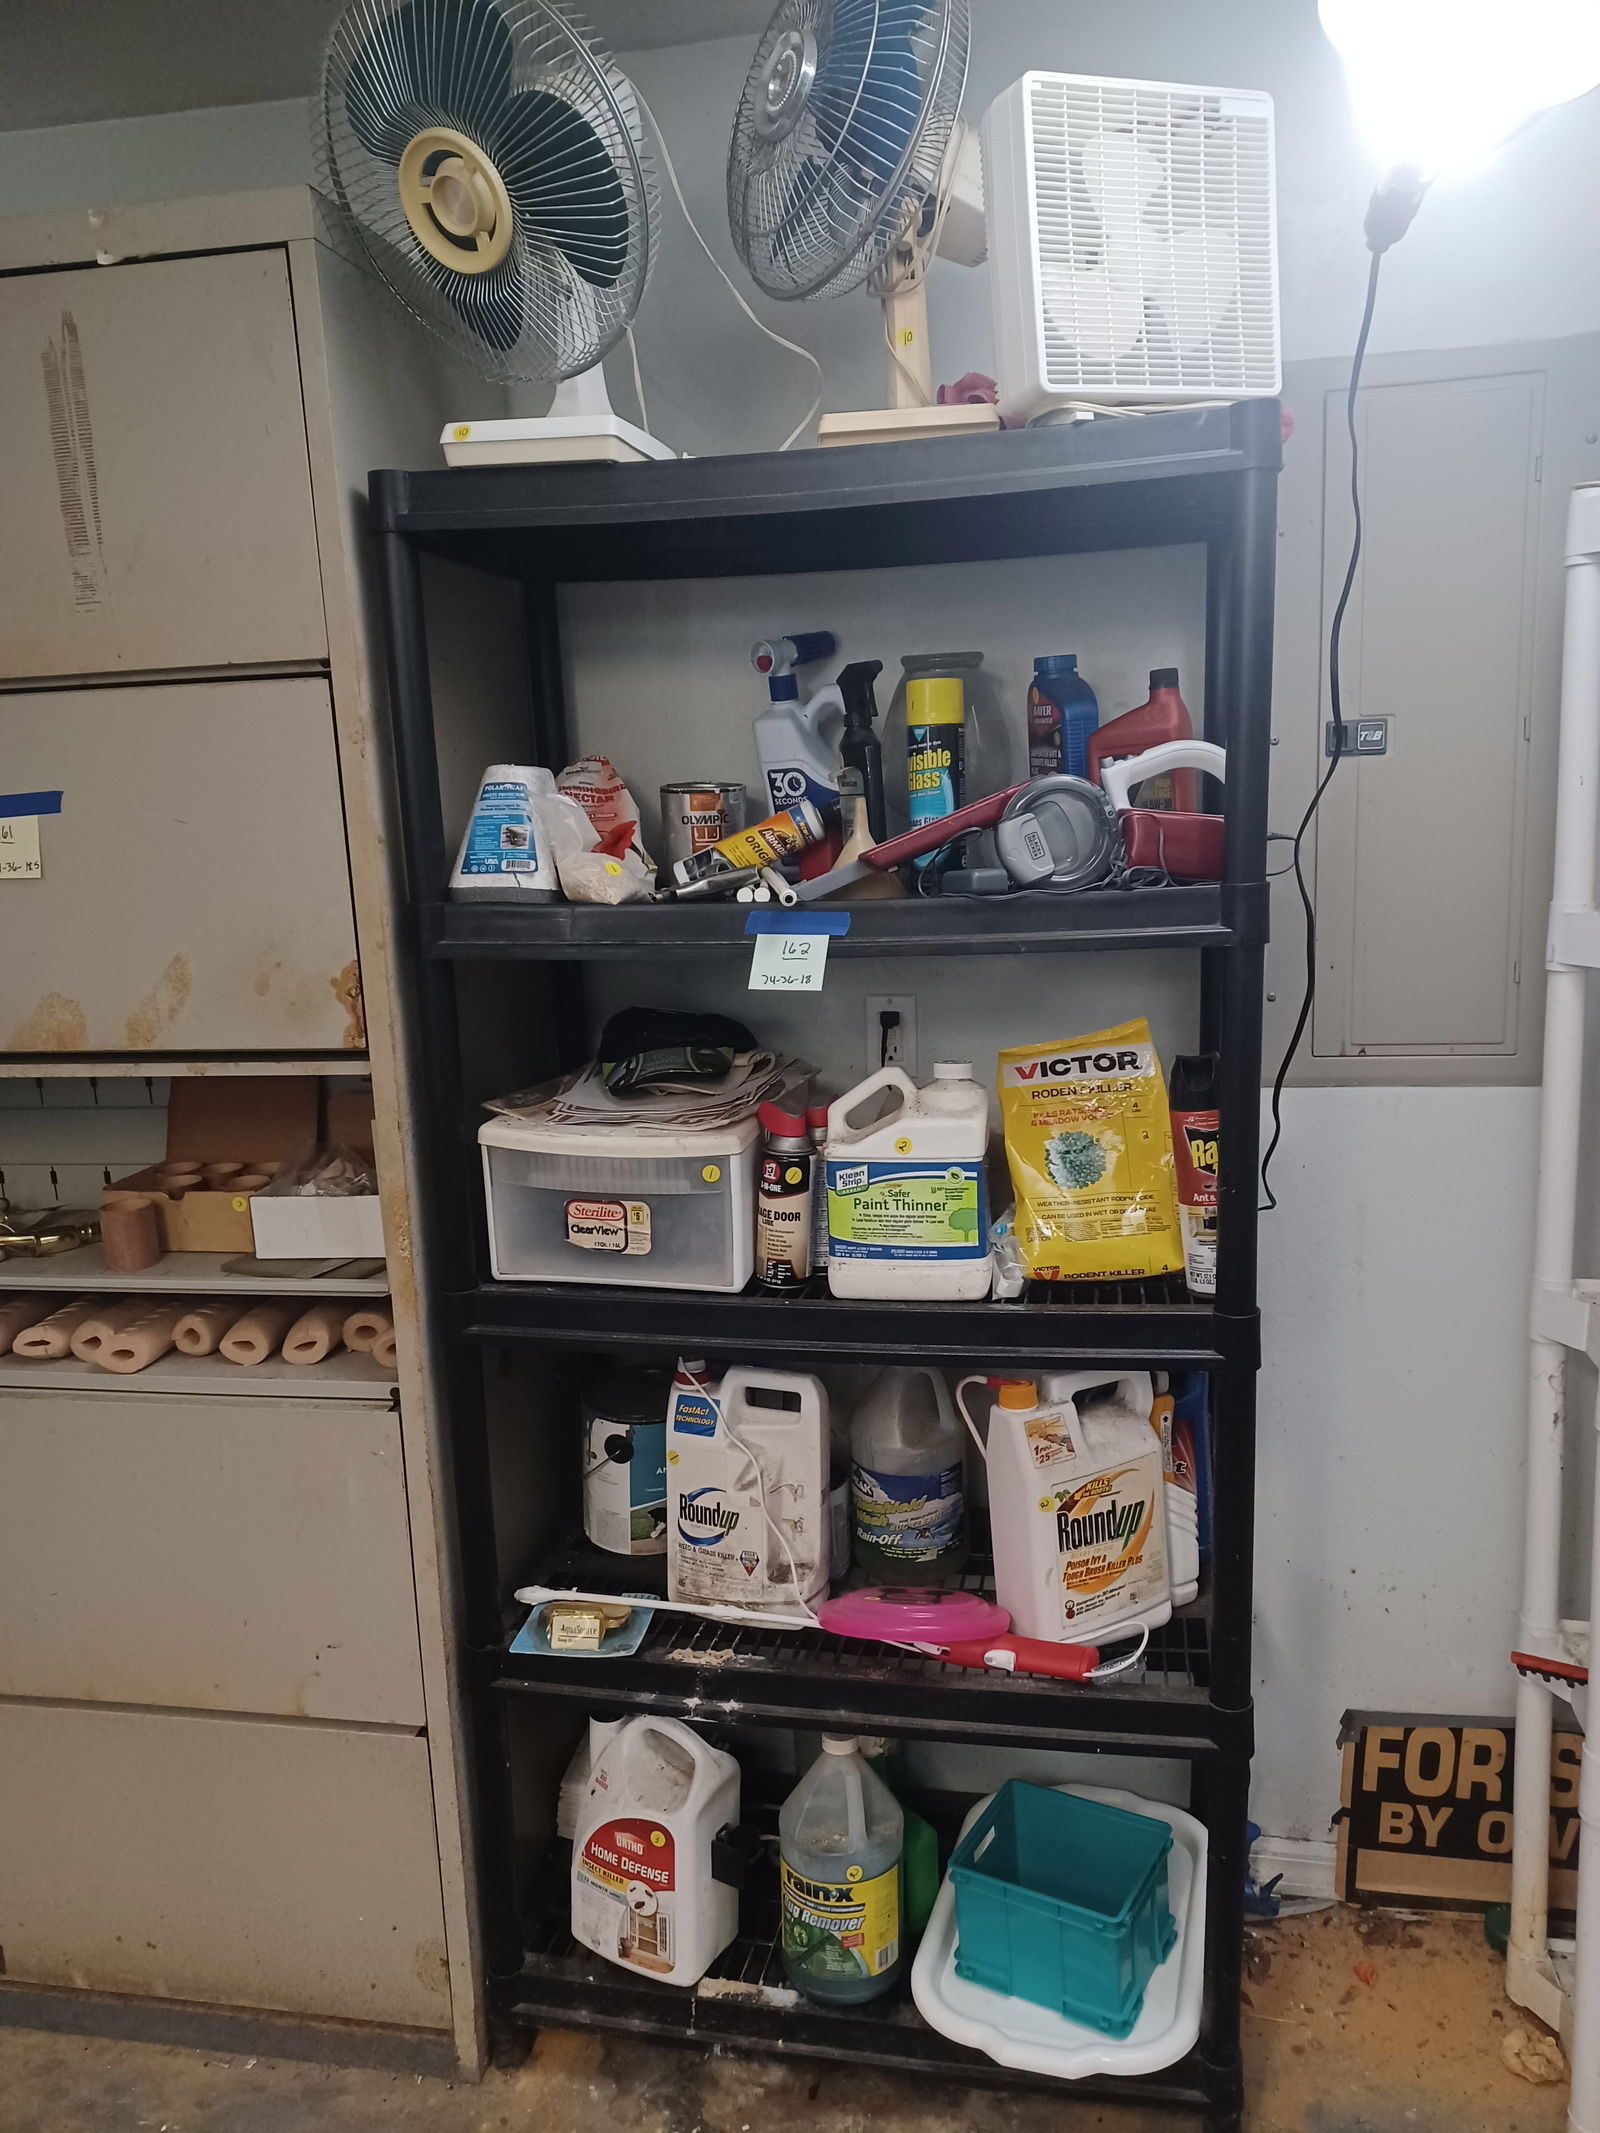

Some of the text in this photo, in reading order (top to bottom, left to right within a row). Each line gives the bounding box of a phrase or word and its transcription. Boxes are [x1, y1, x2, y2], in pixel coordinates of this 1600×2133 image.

[903, 331, 913, 346] 10
[770, 771, 807, 798] 30
[908, 771, 941, 792] Glass
[564, 791, 614, 803] NECTAR
[774, 796, 808, 806] SECONDS
[782, 940, 811, 956] 162
[1014, 1050, 1140, 1081] VICTOR
[1132, 1101, 1139, 1109] 4
[1190, 1139, 1219, 1169] Ra
[838, 1170, 865, 1181] Klean
[841, 1177, 863, 1188] Strip
[887, 1189, 911, 1198] Safer
[1193, 1193, 1209, 1202] Ant
[573, 1204, 619, 1218] Sterilite
[853, 1197, 949, 1212] Paint Thinner
[773, 1211, 802, 1222] DOOR
[1067, 1210, 1085, 1219] USED
[570, 1224, 620, 1236] ClearView
[1063, 1268, 1146, 1279] RODENT KILLER
[678, 1404, 710, 1416] FastAct
[675, 1414, 716, 1426] TECHNOLOGY
[1086, 1478, 1111, 1491] KILLS
[678, 1492, 740, 1537] Roundup
[1055, 1498, 1146, 1554] Roundup
[857, 1526, 902, 1546] Rain-Off
[678, 1542, 692, 1552] WEED
[698, 1547, 717, 1558] GRASS
[717, 1551, 736, 1561] KILLER
[1062, 1569, 1084, 1583] TOUGH
[1083, 1564, 1106, 1578] BRUSH
[1105, 1558, 1128, 1572] KILLER
[1126, 1554, 1144, 1567] PLUS
[1065, 1557, 1091, 1572] POISON
[1090, 1554, 1102, 1566] IVY
[1362, 1726, 1508, 1802] FOR
[1378, 1801, 1454, 1848] BY
[616, 1836, 645, 1856] ORTHO
[590, 1841, 670, 1884] HOME DEFENSE
[582, 1857, 625, 1885] INSECT KILLER
[800, 1908, 866, 1933] Remover
